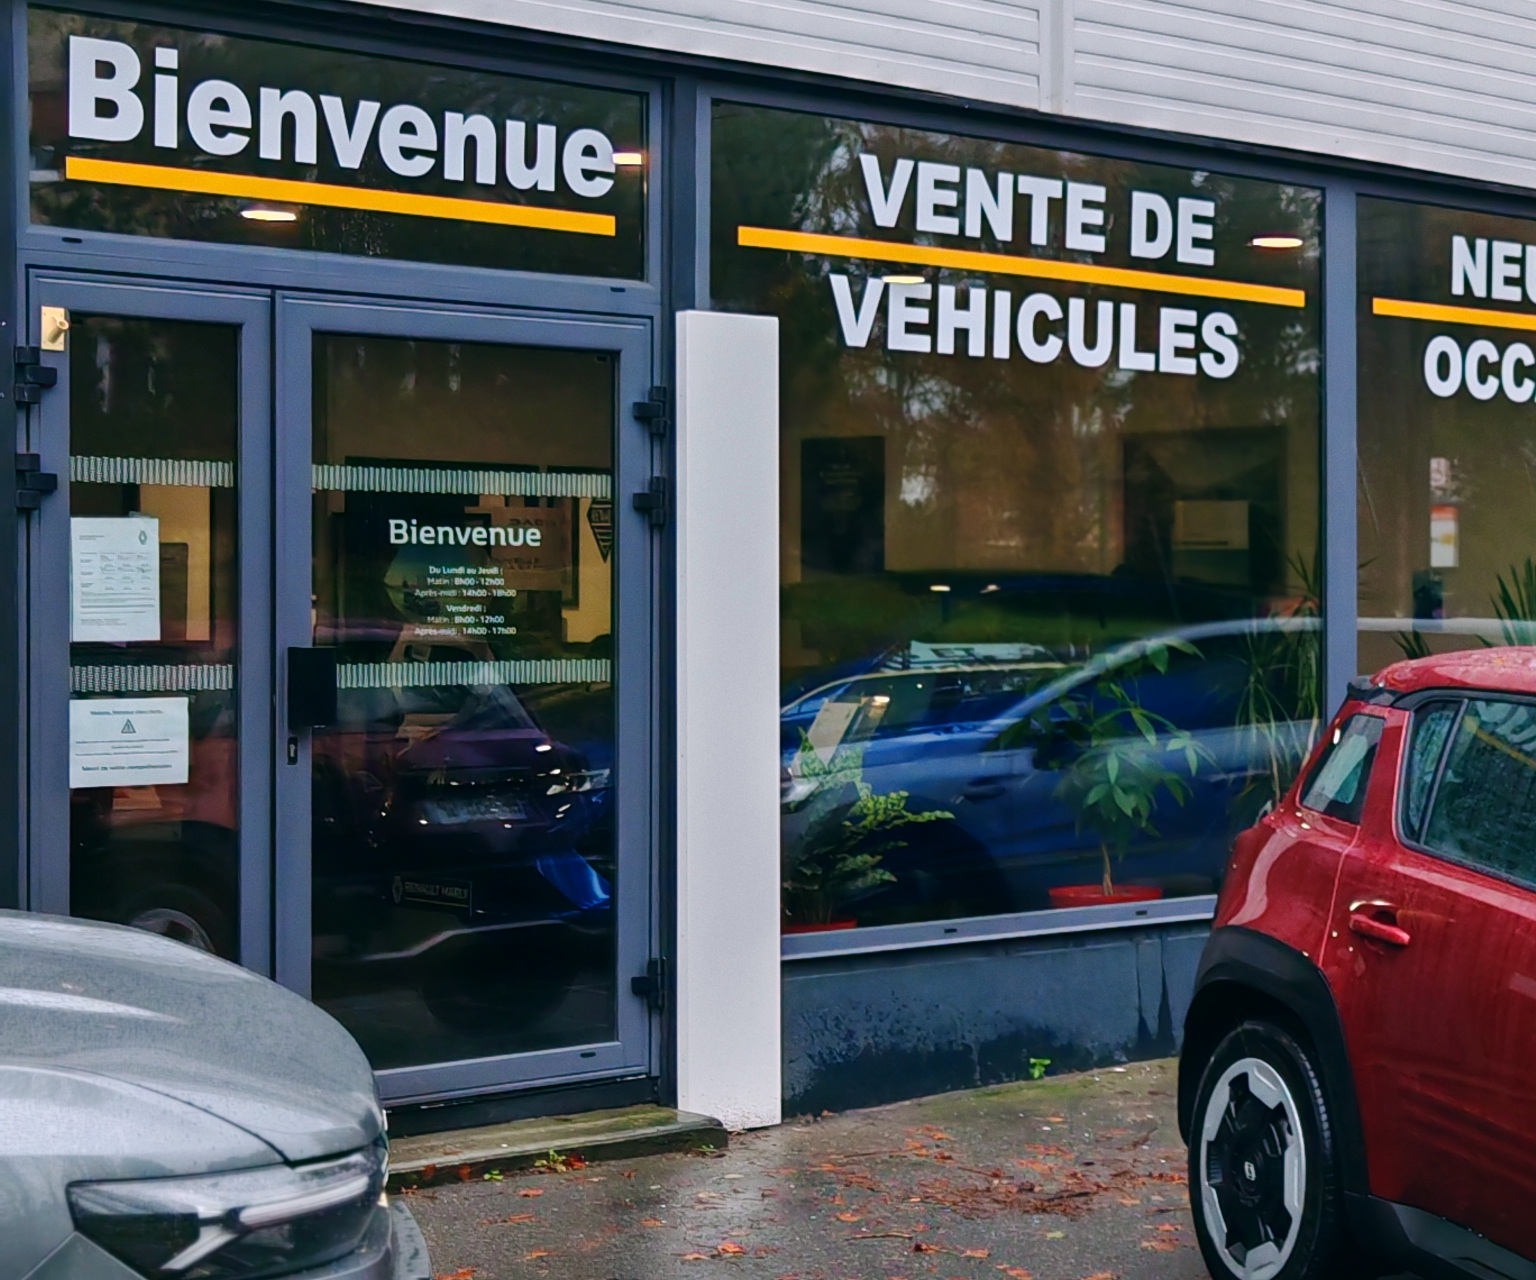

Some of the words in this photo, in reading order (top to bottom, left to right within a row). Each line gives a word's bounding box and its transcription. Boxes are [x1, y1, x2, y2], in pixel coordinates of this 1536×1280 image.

[68, 35, 616, 198] Bienvenue
[859, 153, 1106, 253] VENTE
[1130, 191, 1216, 266] DE
[829, 274, 1239, 379] VEHICULES
[388, 519, 542, 547] Bienvenue
[428, 566, 440, 575] Du
[442, 566, 465, 575] Lundi
[478, 566, 499, 576] Jeudi
[426, 577, 450, 586] Matin
[445, 604, 483, 613] Vendredi
[426, 616, 450, 625] Matin
